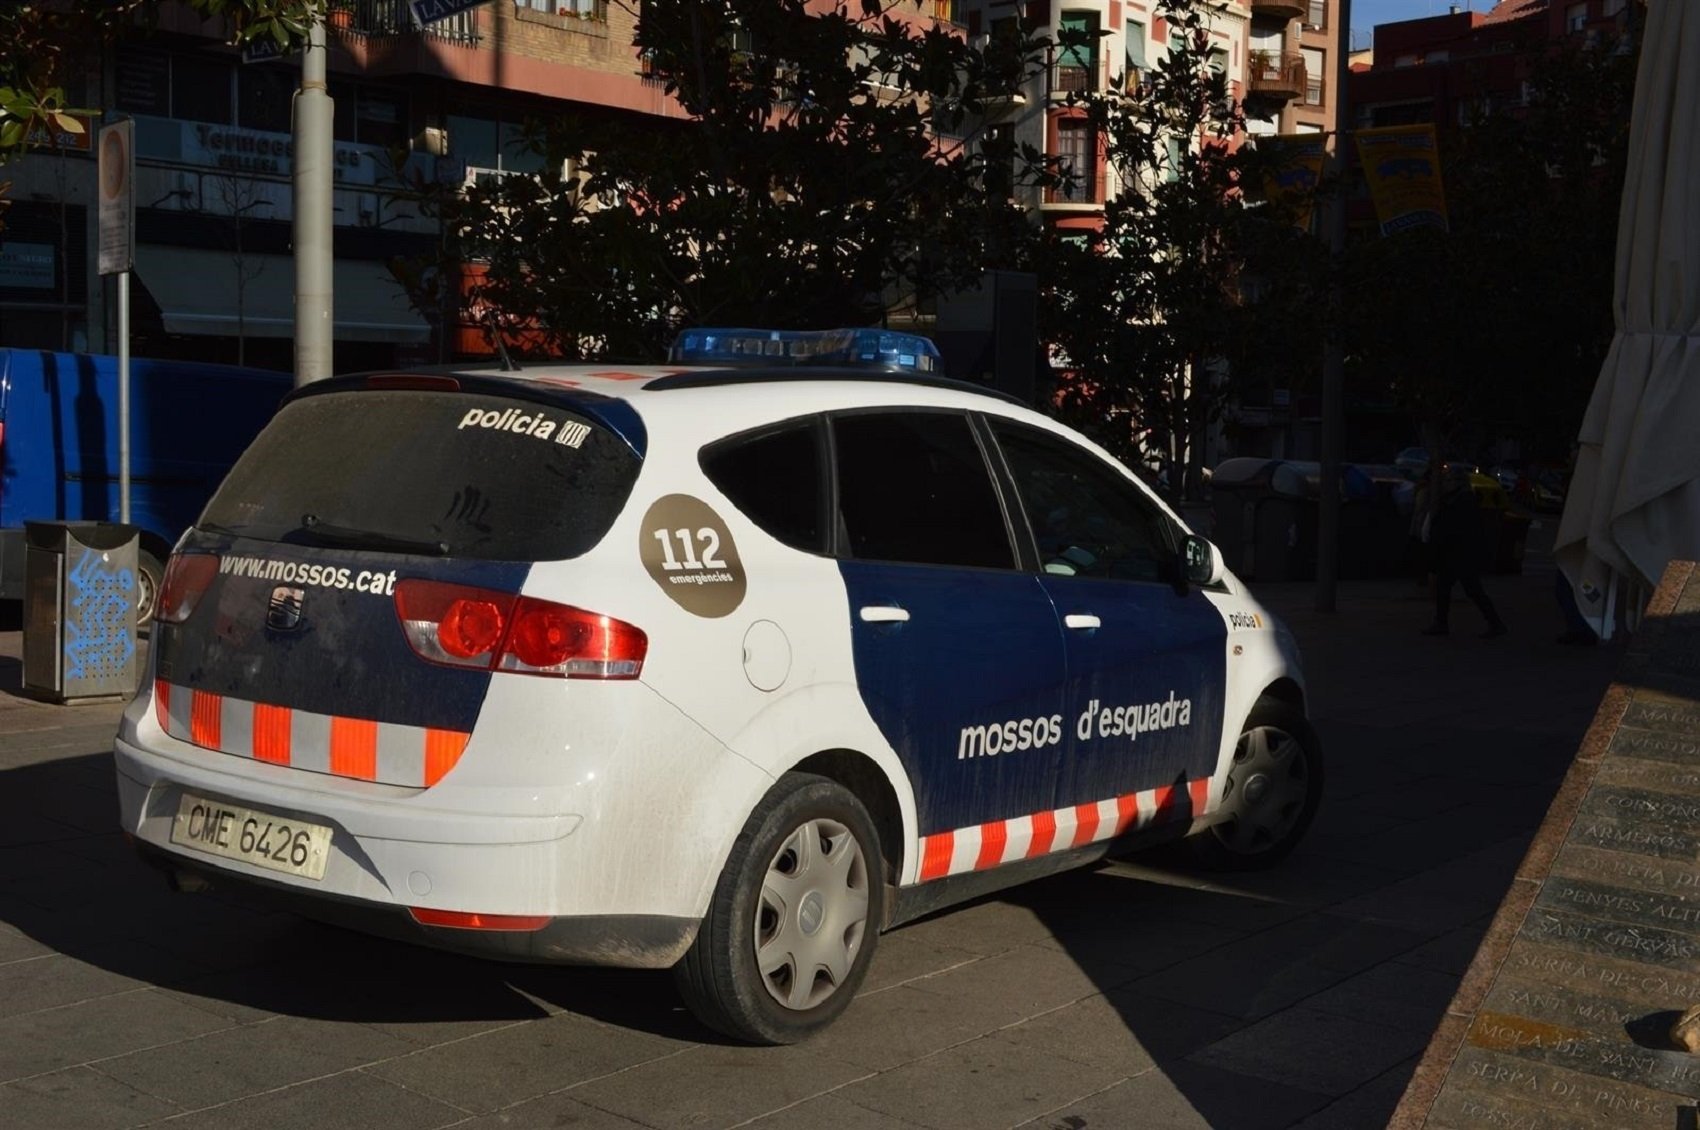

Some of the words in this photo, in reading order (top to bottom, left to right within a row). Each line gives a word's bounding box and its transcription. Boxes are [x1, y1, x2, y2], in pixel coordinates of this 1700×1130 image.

[457, 408, 557, 441] policia
[654, 527, 727, 570] 112
[219, 555, 397, 597] www.mossos.cat
[1229, 611, 1256, 631] policia
[958, 713, 1063, 760] mossos
[1077, 690, 1191, 741] d'esquadra
[188, 805, 235, 848] CME
[240, 818, 310, 866] 6426
[1561, 887, 1640, 912] PENYES
[1540, 920, 1592, 940] SANT
[1517, 955, 1587, 978] SERRA
[1600, 968, 1629, 986] DE
[1507, 988, 1562, 1011] SANT
[1479, 1022, 1541, 1046] MOLA
[1556, 1034, 1587, 1058] DE
[1601, 1051, 1655, 1073] SANT
[1469, 1061, 1538, 1091] SERRA
